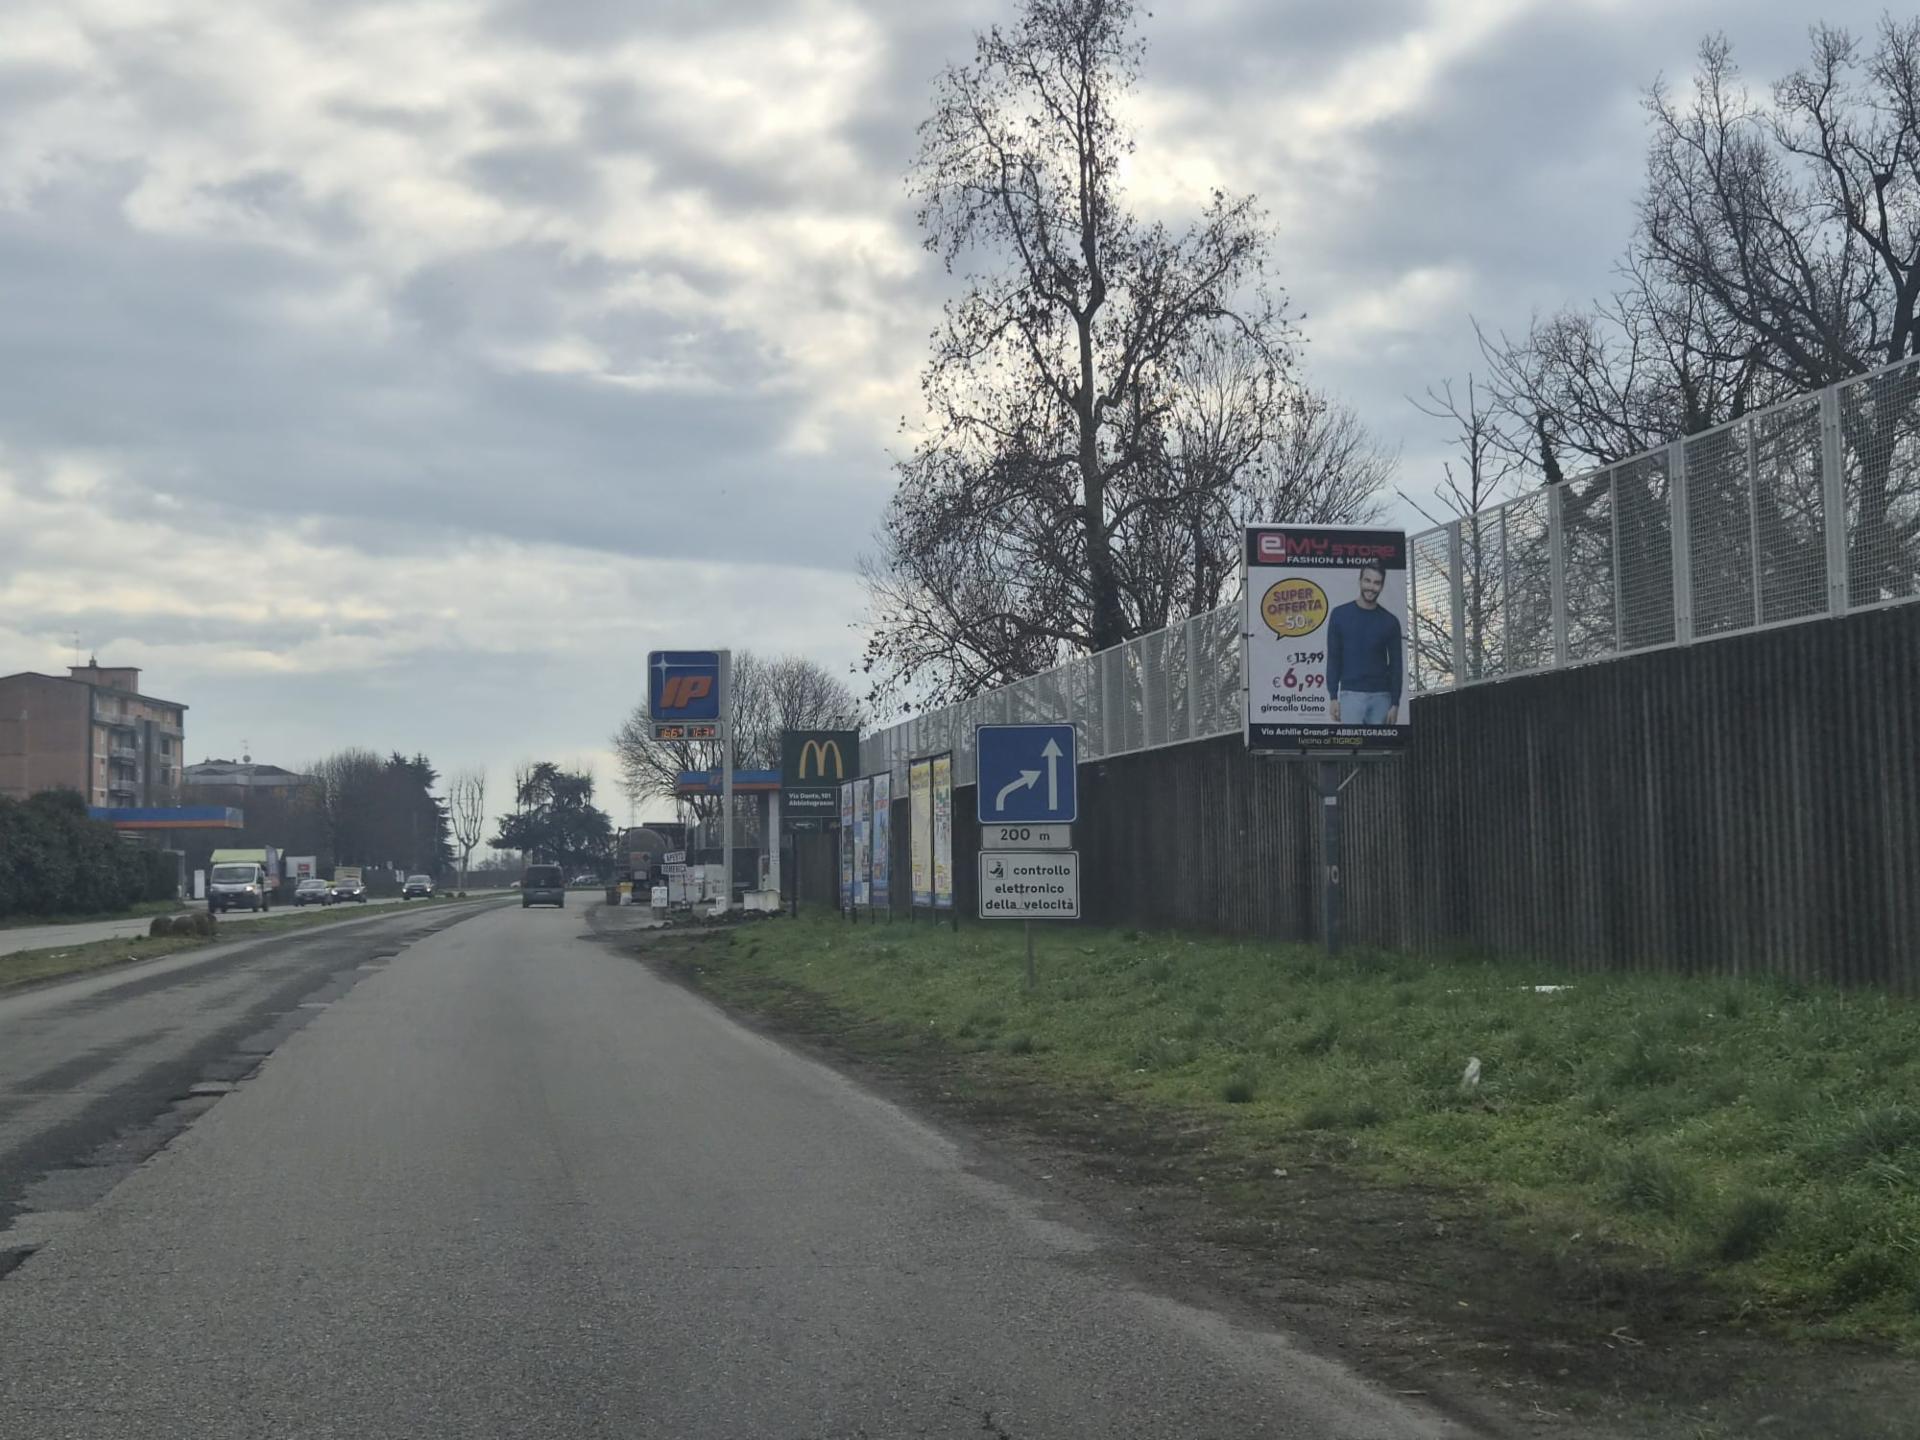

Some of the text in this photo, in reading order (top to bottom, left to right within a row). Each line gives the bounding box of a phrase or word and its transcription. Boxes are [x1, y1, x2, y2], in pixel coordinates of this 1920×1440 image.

[1287, 538, 1328, 555] MY
[1287, 556, 1334, 564] FASHION
[1336, 556, 1344, 565] &
[1273, 588, 1313, 601] SUPER
[1267, 599, 1322, 614] OFFERTA
[1284, 667, 1324, 692] 6,99
[660, 676, 712, 708] IP
[1272, 694, 1325, 704] Maglioncino
[1261, 704, 1325, 713] girocollo Uomo
[1303, 728, 1329, 736] Grandi
[1000, 828, 1050, 841] 200 m
[1013, 865, 1071, 875] controllo
[995, 883, 1064, 894] elettronico
[985, 899, 1074, 910] della velocità
